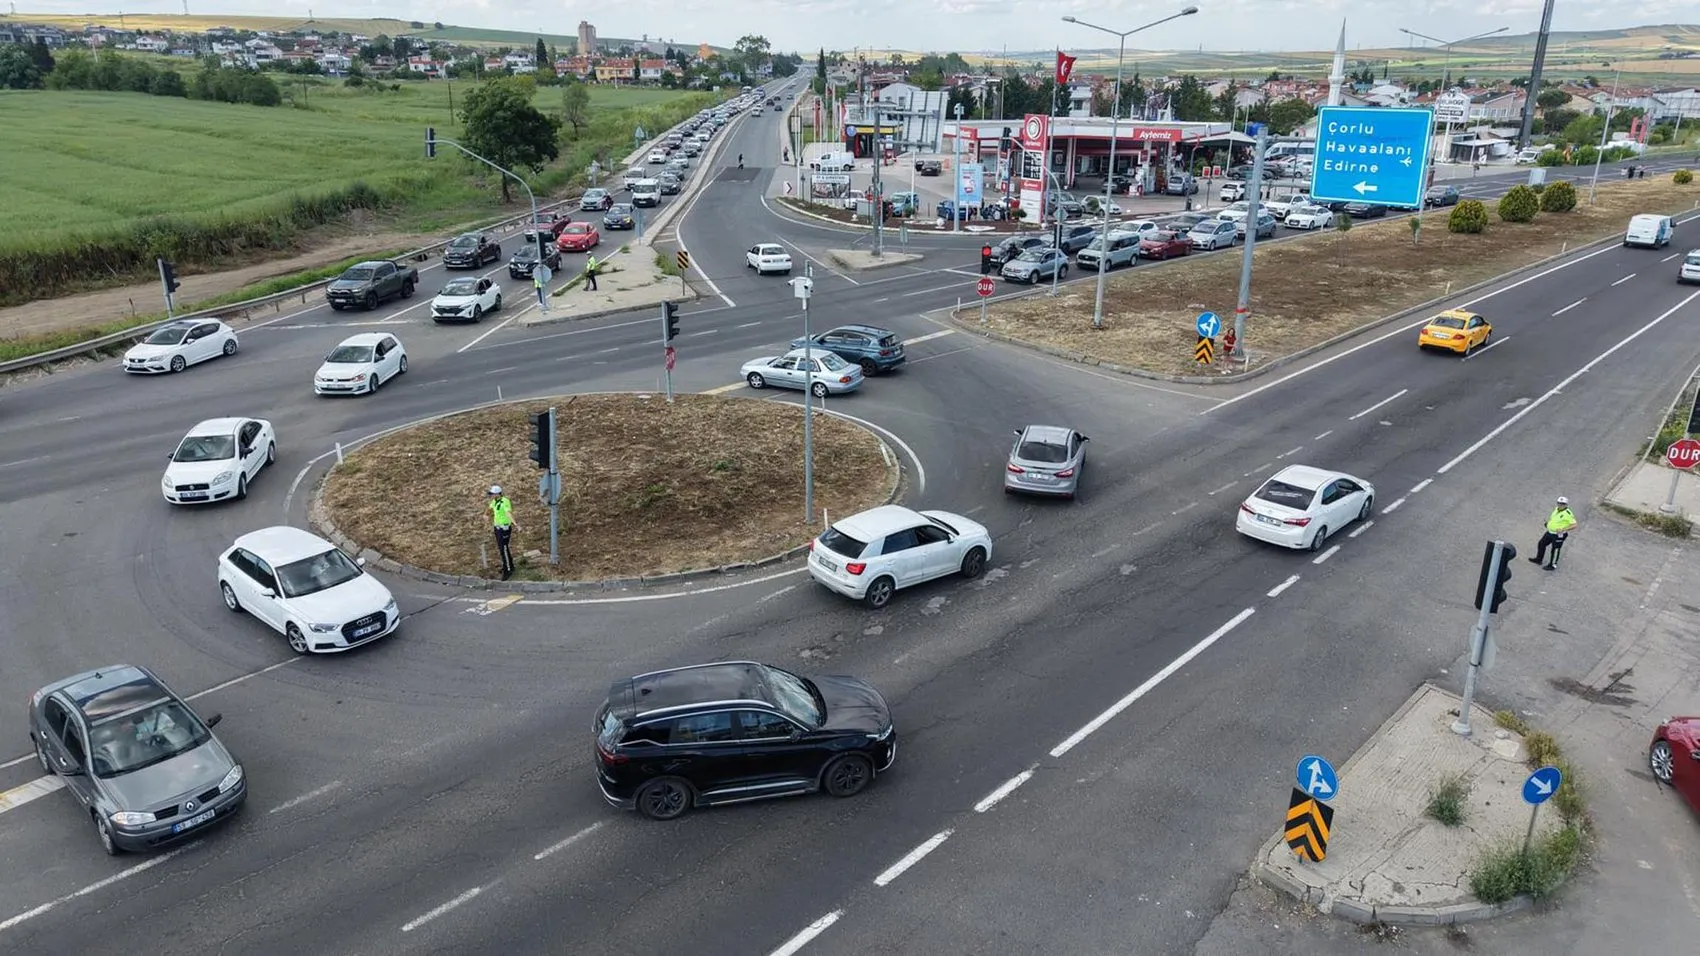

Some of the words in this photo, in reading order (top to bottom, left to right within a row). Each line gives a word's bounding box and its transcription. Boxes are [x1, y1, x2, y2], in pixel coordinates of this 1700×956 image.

[1139, 131, 1172, 139] Aytemiz
[1328, 122, 1374, 135] Çorlu
[1326, 141, 1411, 155] Havaalanı
[1324, 160, 1379, 173] Edirne
[977, 283, 993, 291] DUR
[1669, 447, 1700, 460] DUR
